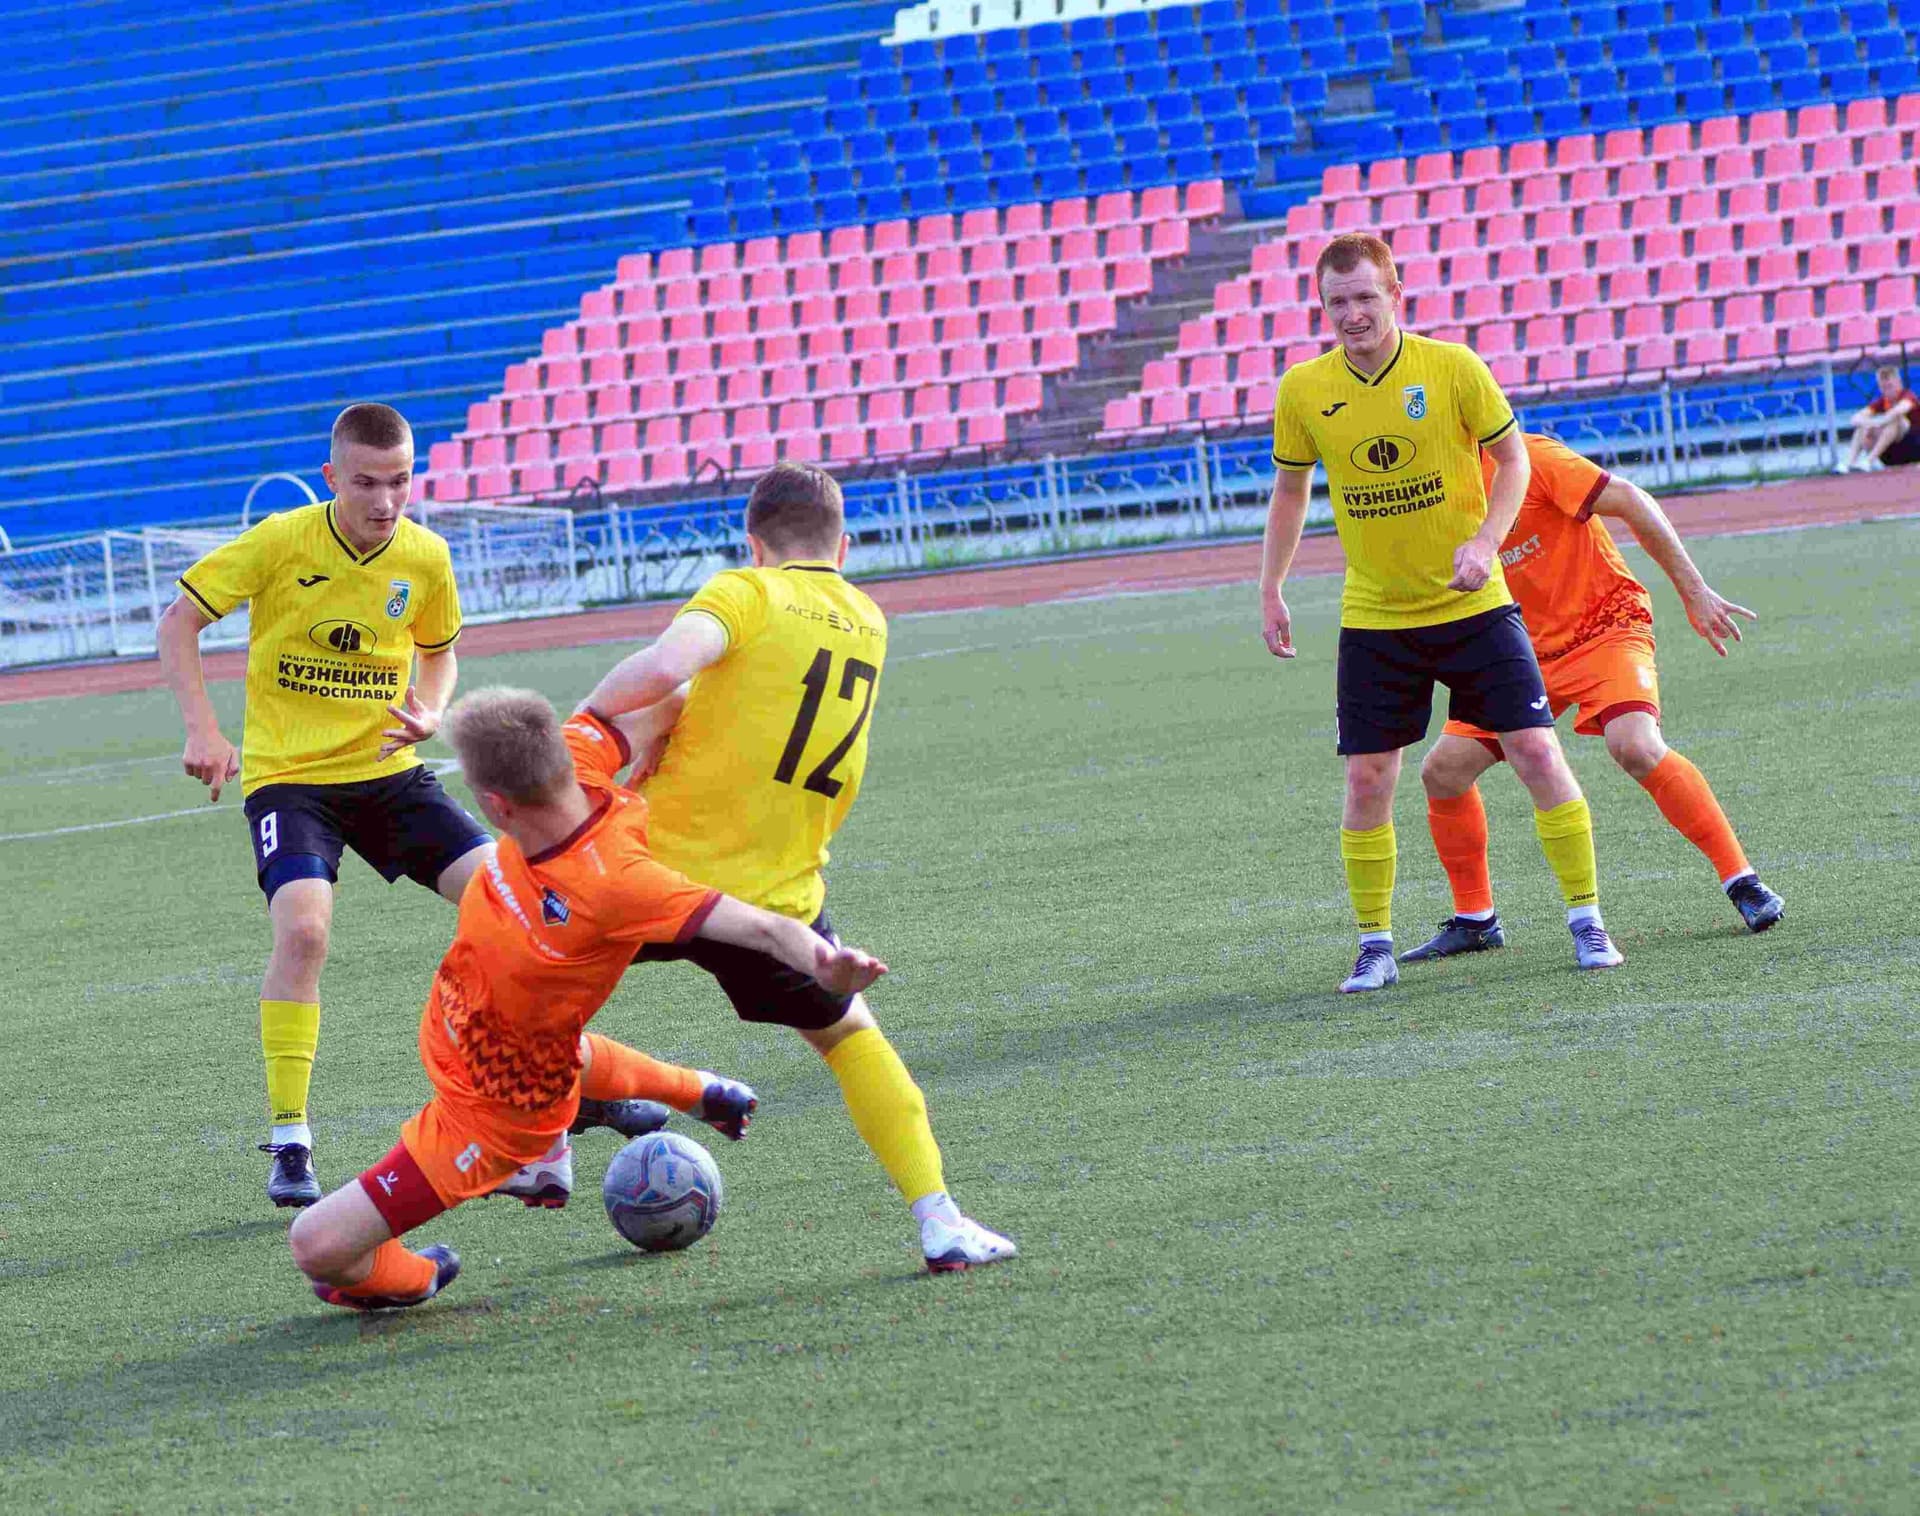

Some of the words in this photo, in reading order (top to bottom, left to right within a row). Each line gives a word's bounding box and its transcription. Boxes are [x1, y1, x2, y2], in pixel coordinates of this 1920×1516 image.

[1343, 477, 1444, 506] КУЗНЕЦКИЕ
[1347, 492, 1446, 519] ФЕРРОСПЛАВЫ
[278, 661, 398, 687] КУЗНЕЦКИЕ
[278, 677, 397, 701] ФЕРРОСПЛАВЫ
[773, 648, 877, 799] 12
[260, 811, 278, 857] 9
[454, 1142, 481, 1173] 6
